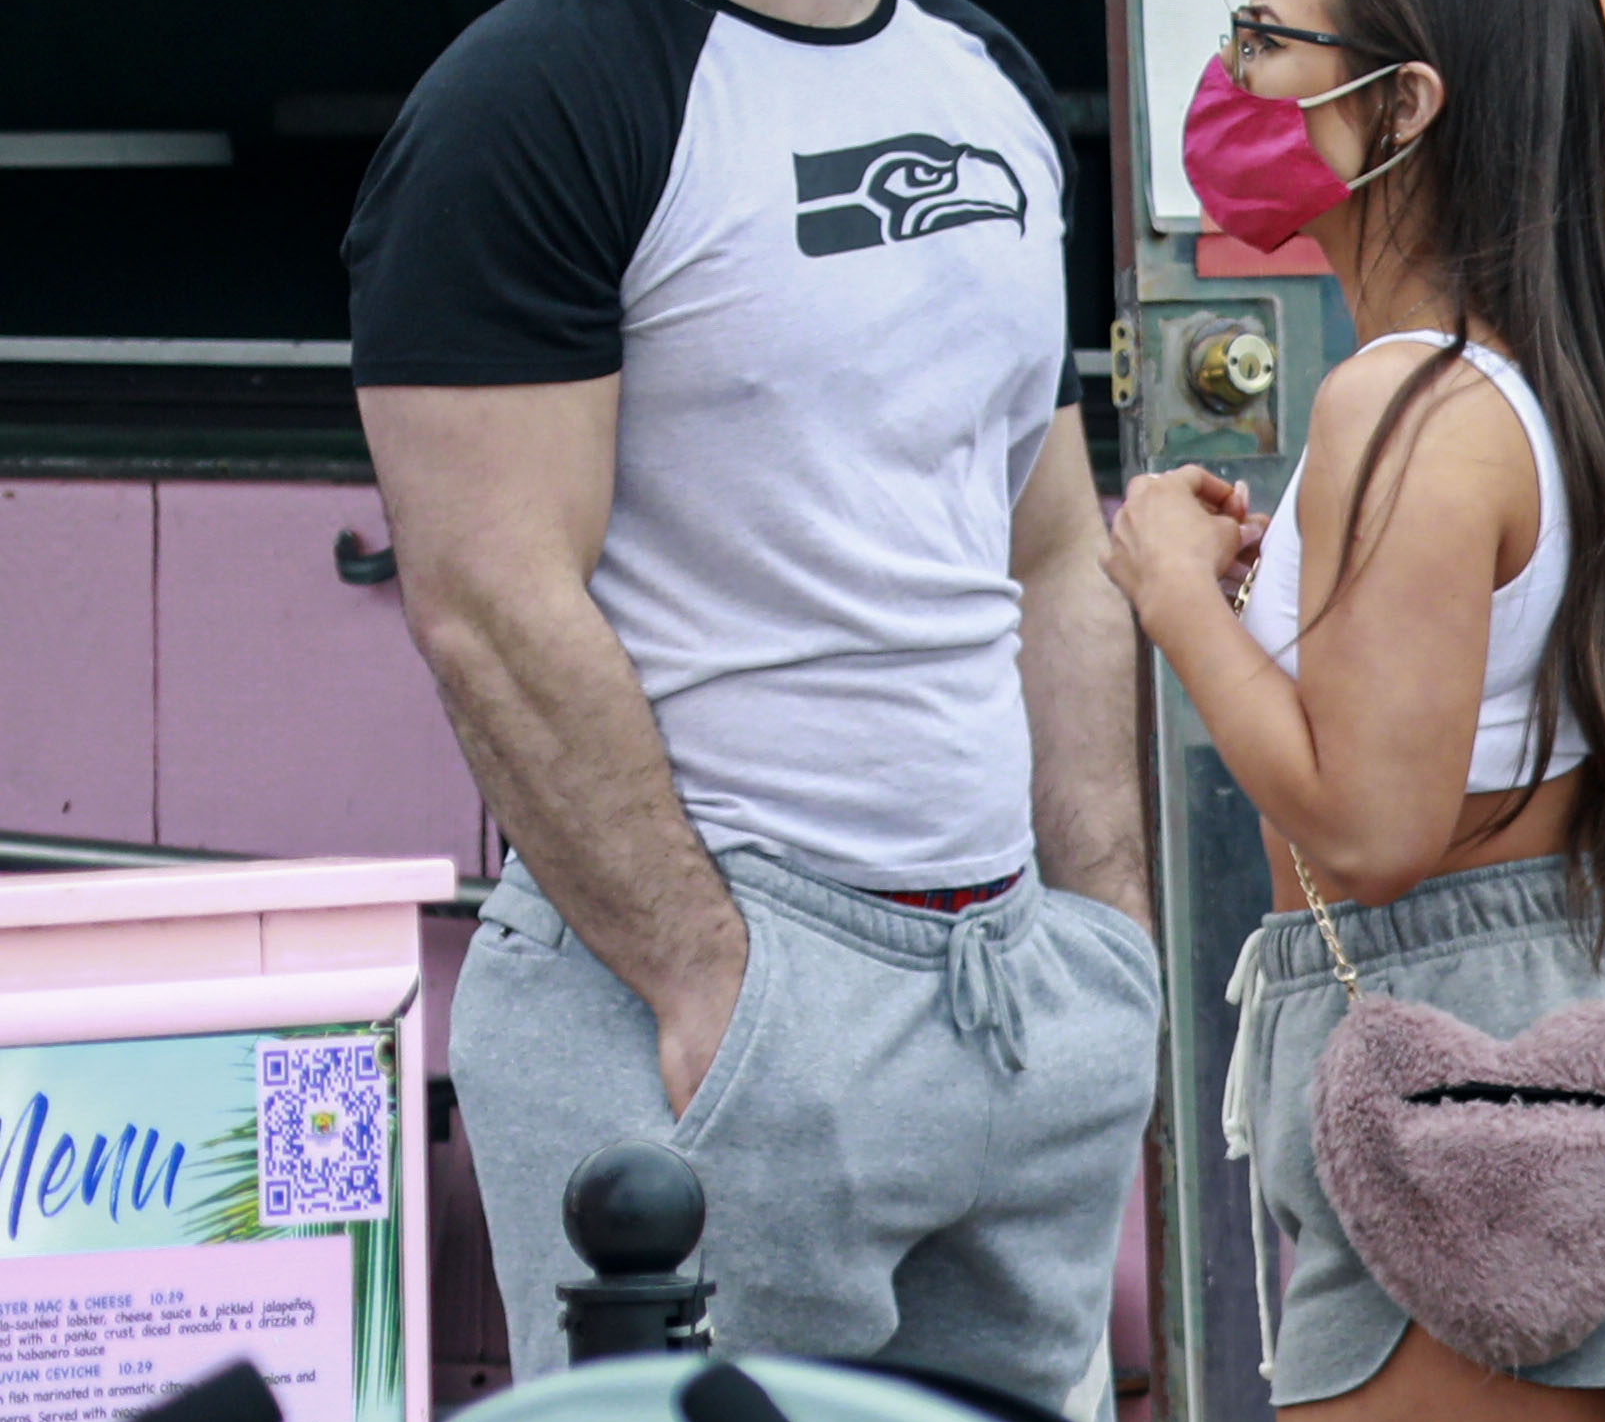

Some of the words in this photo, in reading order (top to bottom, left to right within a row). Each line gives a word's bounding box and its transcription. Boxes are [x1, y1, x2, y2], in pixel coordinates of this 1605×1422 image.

[34, 1299, 63, 1314] MAC
[85, 1294, 132, 1311] CHEESE
[150, 1291, 184, 1306] 10.29
[115, 1311, 152, 1325] cheese
[160, 1308, 192, 1321] sauce
[215, 1302, 254, 1320] pickled
[17, 1347, 70, 1362] habanero
[74, 1345, 105, 1358] sauce
[45, 1364, 101, 1380] CEVICHE
[118, 1361, 153, 1376] 10.29
